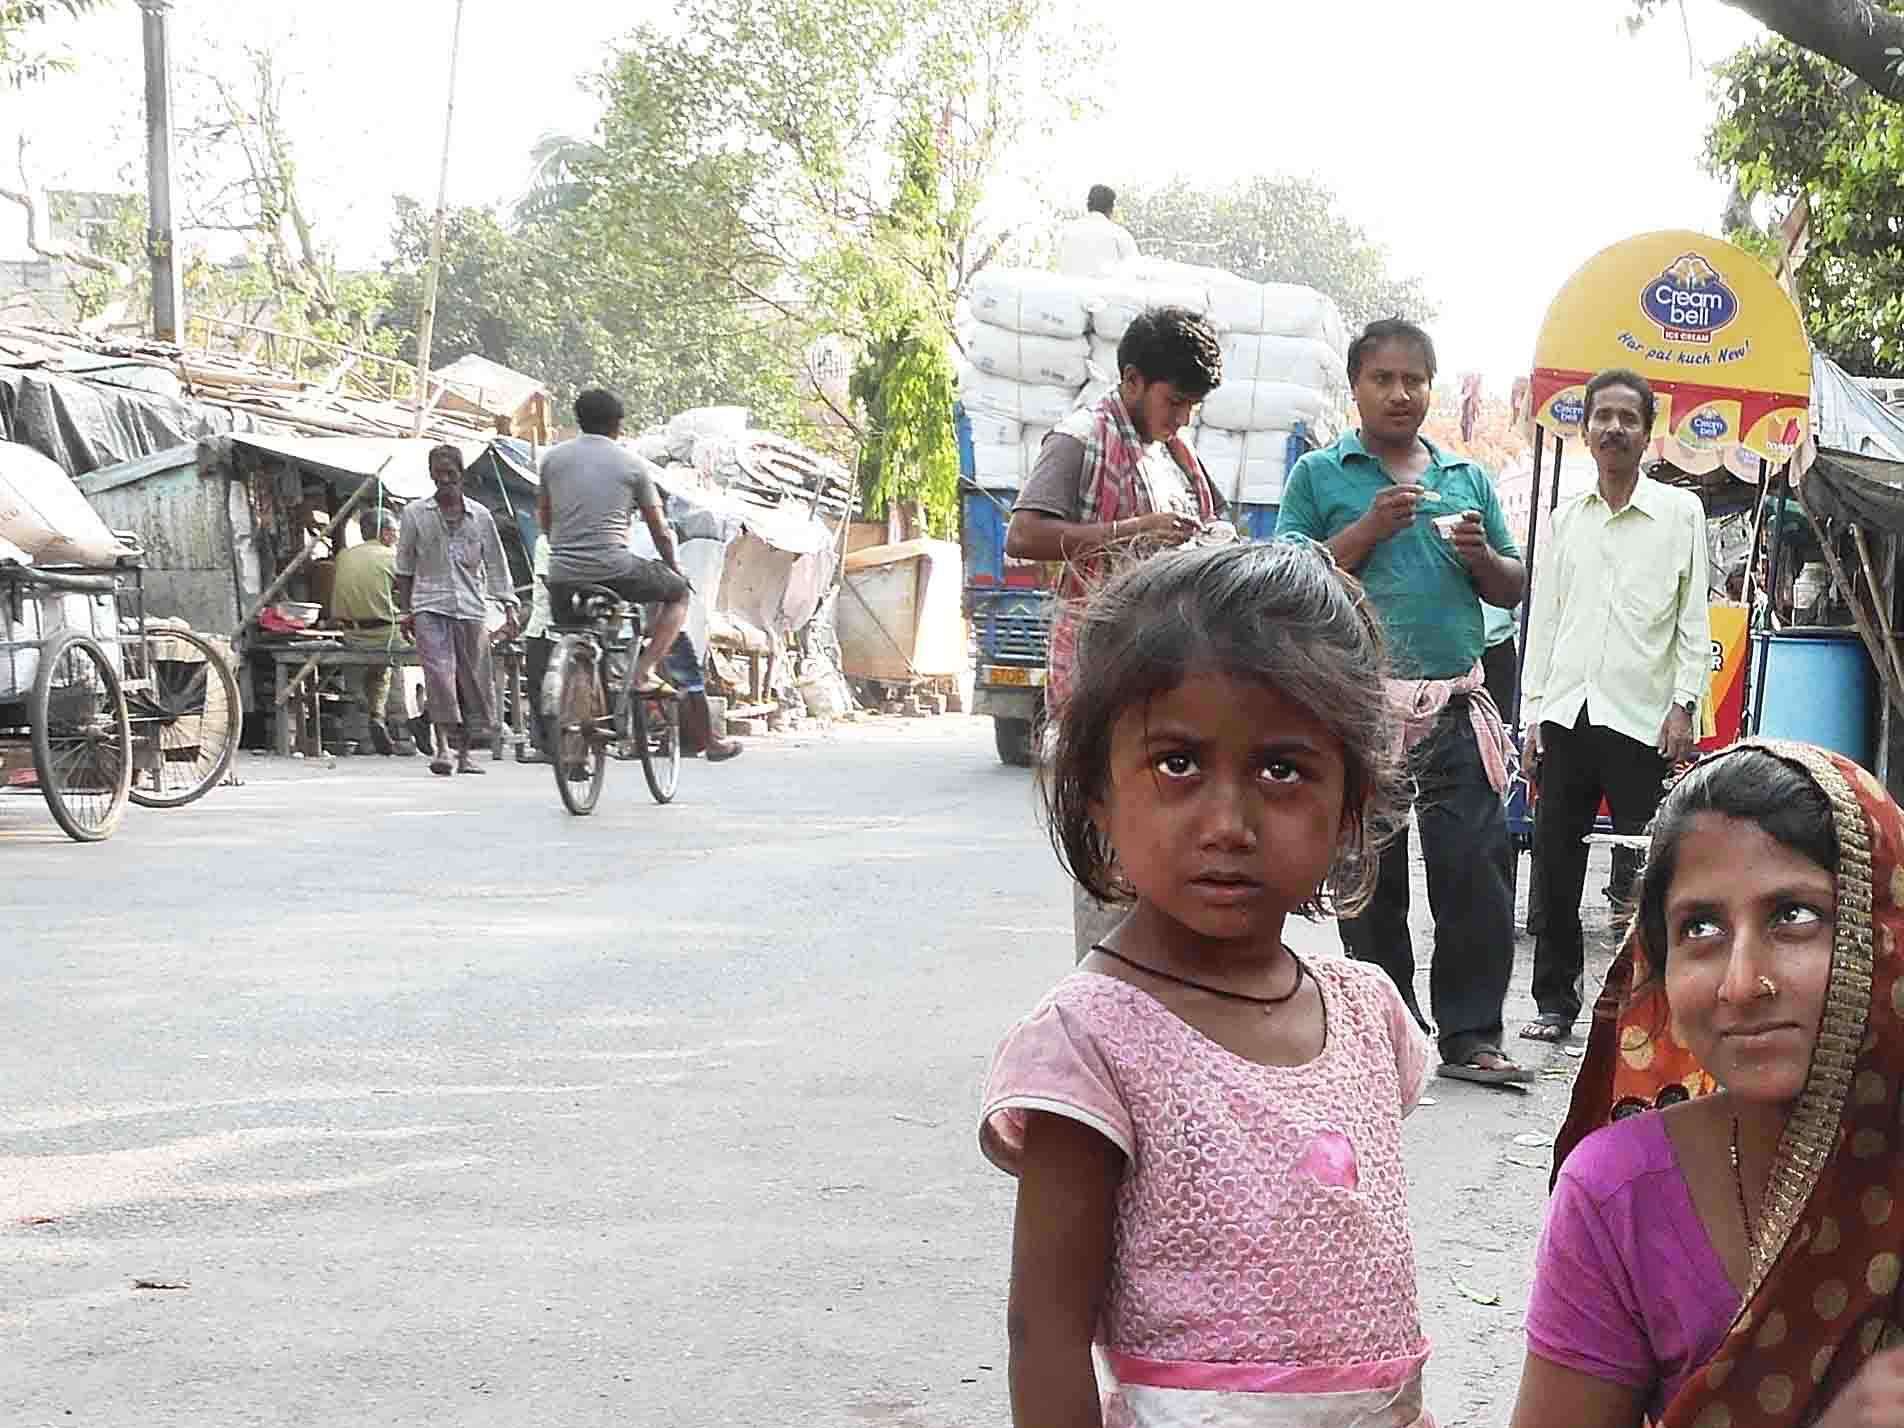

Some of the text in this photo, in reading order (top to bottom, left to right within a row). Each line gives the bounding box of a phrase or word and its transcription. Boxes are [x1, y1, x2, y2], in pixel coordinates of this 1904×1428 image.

[1655, 285, 1722, 310] Cream
[1670, 305, 1710, 326] bell
[1617, 331, 1750, 365] Har pal kuch New!
[1680, 332, 1710, 342] CREAM
